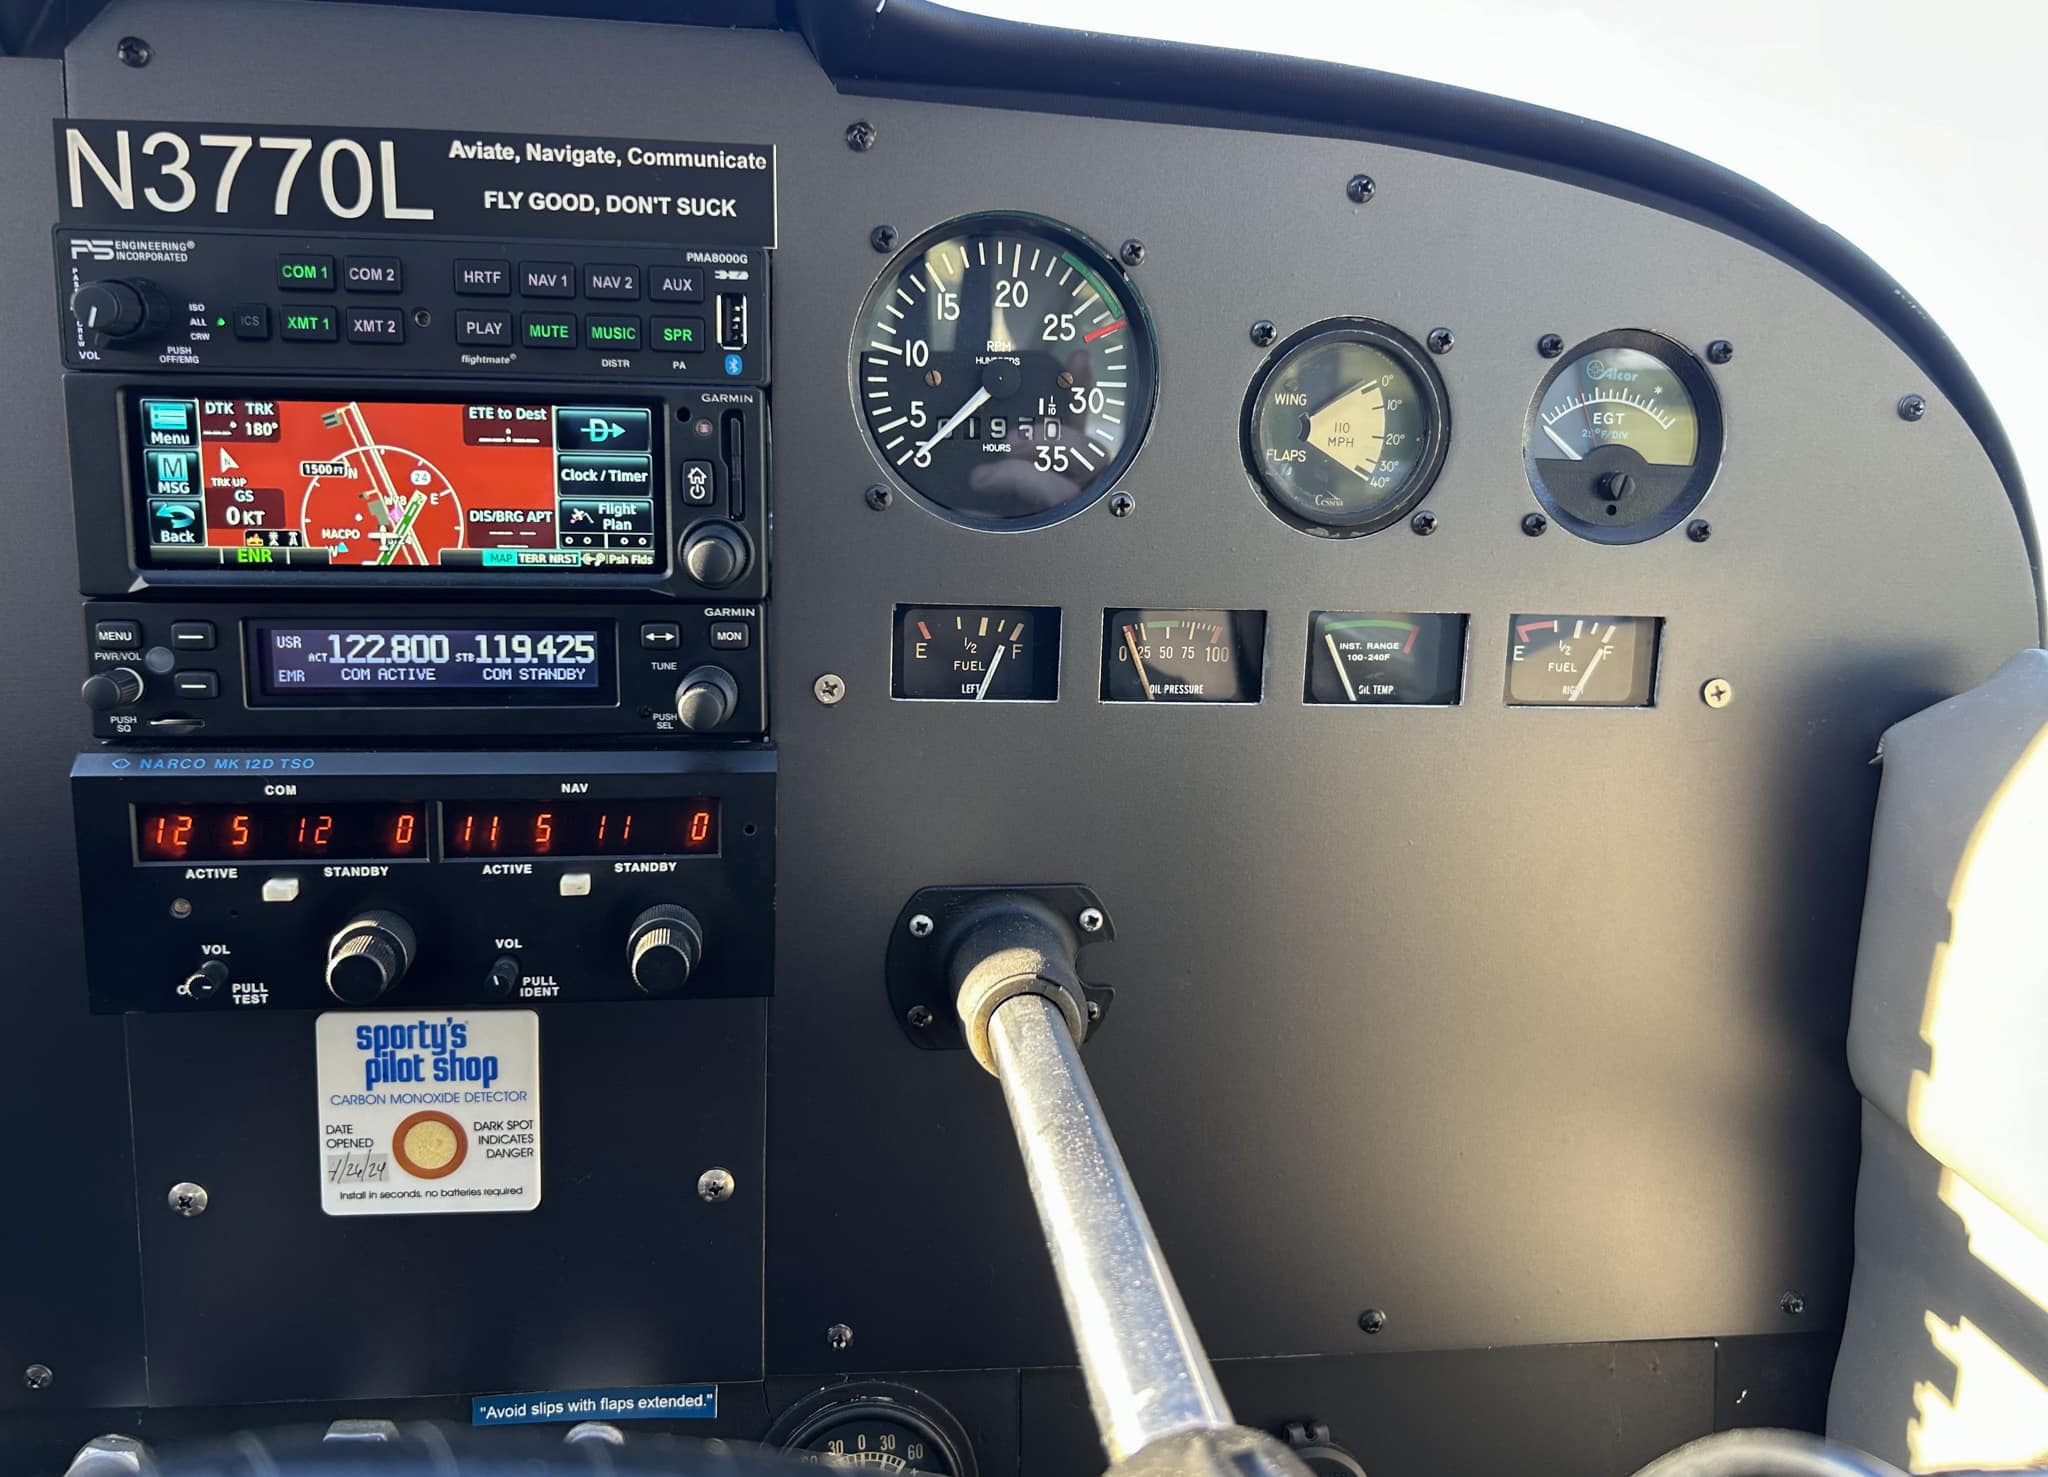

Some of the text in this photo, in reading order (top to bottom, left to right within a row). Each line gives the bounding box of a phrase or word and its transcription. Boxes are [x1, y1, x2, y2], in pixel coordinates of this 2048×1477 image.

[449, 140, 767, 170] Aviate, Navigate, Communicate
[66, 129, 434, 220] N3770L
[484, 190, 737, 217] FLY GOOD, DON'T SUCK
[116, 251, 188, 262] INCORPORATED
[686, 252, 748, 265] PMA8000G
[282, 265, 316, 279] COM
[349, 268, 395, 282] COM 2
[464, 271, 502, 284] HRTF
[528, 274, 558, 287] NAV
[592, 276, 633, 289] NAV 2
[663, 278, 693, 292] AUX
[995, 280, 1028, 308] 20
[189, 304, 205, 312] ISO
[937, 293, 960, 320] 15
[190, 318, 208, 327] ALL
[241, 315, 260, 326] ICS
[287, 316, 318, 330] XMT
[353, 319, 396, 333] XMT 2
[466, 322, 502, 335] PLAY
[529, 325, 569, 338] MUTE
[592, 326, 636, 340] MUSIC
[1042, 314, 1076, 341] 25
[190, 332, 210, 341] CRW
[663, 328, 693, 342] SPR
[167, 346, 192, 355] PUSH
[986, 340, 1012, 352] RPM
[79, 350, 100, 361] VOL
[159, 354, 200, 365] OFF/EMG
[905, 339, 929, 367] 10
[602, 359, 630, 369] DISTR
[672, 360, 687, 370] PA
[701, 394, 753, 403] GARMIN
[1069, 386, 1104, 414] 30
[1275, 393, 1307, 406] WING
[205, 402, 235, 415] DTK
[245, 403, 275, 415] TRK
[469, 407, 547, 421] ETE to Dest
[910, 401, 927, 428] 5
[1593, 413, 1625, 425] EGT
[1334, 422, 1350, 433] 110
[151, 432, 190, 445] Menu
[1327, 436, 1354, 448] MPH
[982, 444, 1012, 452] HOURS
[1034, 446, 1069, 472] 35
[1266, 449, 1306, 462] FLAPS
[561, 469, 648, 482] Clock Timer
[158, 482, 190, 494] MSG
[232, 478, 247, 488] UP
[234, 490, 255, 503] GS
[430, 493, 439, 505] E
[469, 510, 552, 523] DIS/BRG APT
[598, 503, 637, 517] Flight
[602, 518, 632, 531] Plan
[160, 530, 195, 543] Back
[322, 529, 360, 540] MACPO
[237, 549, 273, 563] ENR
[490, 553, 513, 563] MAP
[518, 553, 547, 564] TERR
[549, 553, 577, 564] NRST
[704, 607, 755, 617] GARMIN
[99, 631, 132, 641] MENU
[276, 636, 302, 649] USR
[717, 631, 742, 641] MON
[308, 634, 595, 664] ACT 122.800 STB 119.425
[916, 643, 927, 658] E
[1012, 644, 1024, 659] F
[1138, 646, 1151, 659] 25
[1160, 646, 1173, 659] 50
[1182, 646, 1195, 659] 75
[1340, 642, 1400, 650] INST. RANGE
[95, 652, 142, 661] PWR/VOL
[1119, 646, 1127, 661] 0
[1205, 646, 1229, 662] 100
[1347, 653, 1390, 661] 100-240F
[1513, 645, 1525, 661] E
[1602, 645, 1614, 661] F
[651, 662, 677, 671] TUNE
[953, 661, 985, 672] FUEL
[1548, 662, 1577, 672] FUEL
[278, 669, 305, 682] EMR
[340, 667, 436, 681] COM ACTIVE
[483, 668, 586, 681] COM STANDBY
[961, 684, 980, 694] LEFT
[1149, 684, 1204, 695] OIL PRESSURE
[1358, 685, 1371, 695] OIL
[110, 715, 137, 725] PUSH
[653, 713, 677, 721] PUSH
[116, 724, 131, 733] SQ
[656, 721, 674, 730] SEL
[139, 758, 316, 769] NARCO MK 12D TSO
[264, 785, 297, 796] COM
[561, 783, 589, 793] NAV
[395, 814, 414, 844] 0
[691, 812, 710, 841] 0
[185, 868, 239, 880] ACTIVE
[324, 866, 389, 877] STANDBY
[482, 864, 533, 875] ACTIVE
[614, 862, 677, 873] STANDBY
[202, 944, 231, 955] VOL
[495, 939, 523, 949] VOL
[522, 976, 557, 987] PULL
[232, 983, 268, 994] PULL
[520, 986, 560, 997] IDENT
[232, 994, 269, 1005] TEST
[356, 1017, 467, 1058] sporty's
[365, 1048, 498, 1091] pilot shop
[330, 1090, 527, 1106] CARBON MONOXIDE DETECTOR
[326, 1124, 353, 1135] DATE
[473, 1120, 533, 1131] DARK SPOT
[326, 1138, 373, 1148] OPENED
[478, 1134, 534, 1145] INDICATES
[486, 1148, 534, 1158] DANGER
[340, 1187, 523, 1200] Install batteries required
[531, 1400, 564, 1418] slips
[567, 1398, 596, 1413] with
[599, 1396, 634, 1414] flaps
[858, 1434, 866, 1450] 0
[880, 1434, 896, 1451] 30
[907, 1443, 924, 1460] 60
